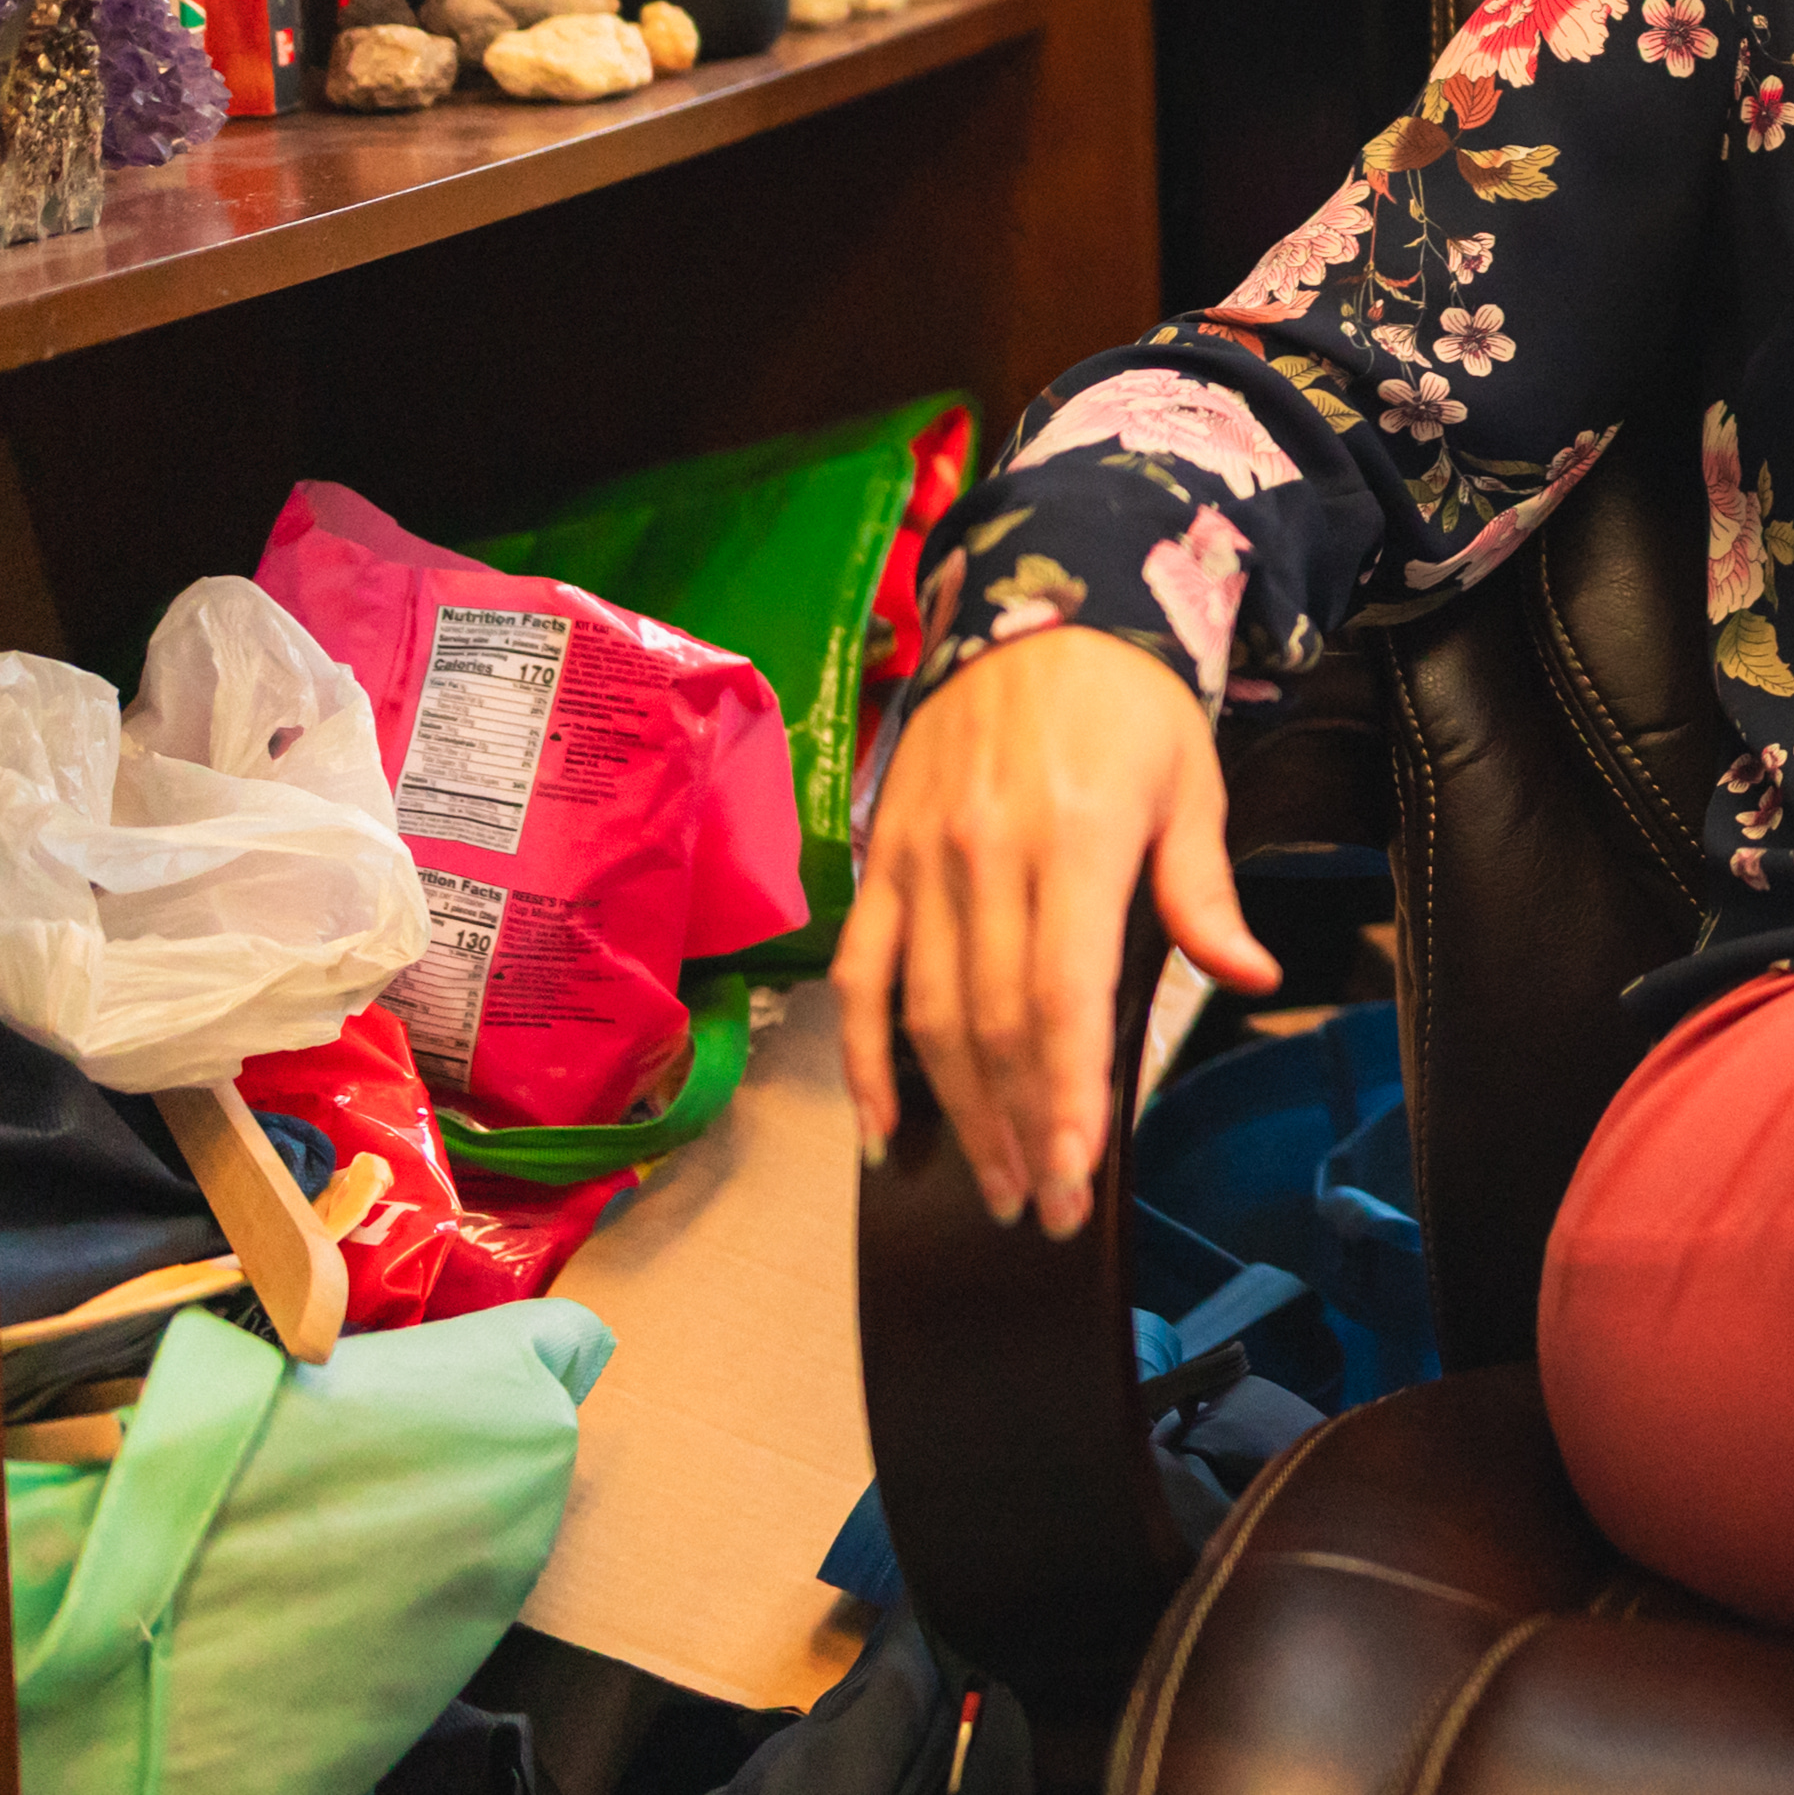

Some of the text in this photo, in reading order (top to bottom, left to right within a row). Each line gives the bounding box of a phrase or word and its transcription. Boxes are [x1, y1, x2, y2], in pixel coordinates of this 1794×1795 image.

[441, 608, 568, 634] Nutrition Facts
[433, 658, 556, 685] Calories 170
[417, 871, 456, 890] rition
[461, 879, 503, 902] Facts
[455, 929, 492, 953] 130
